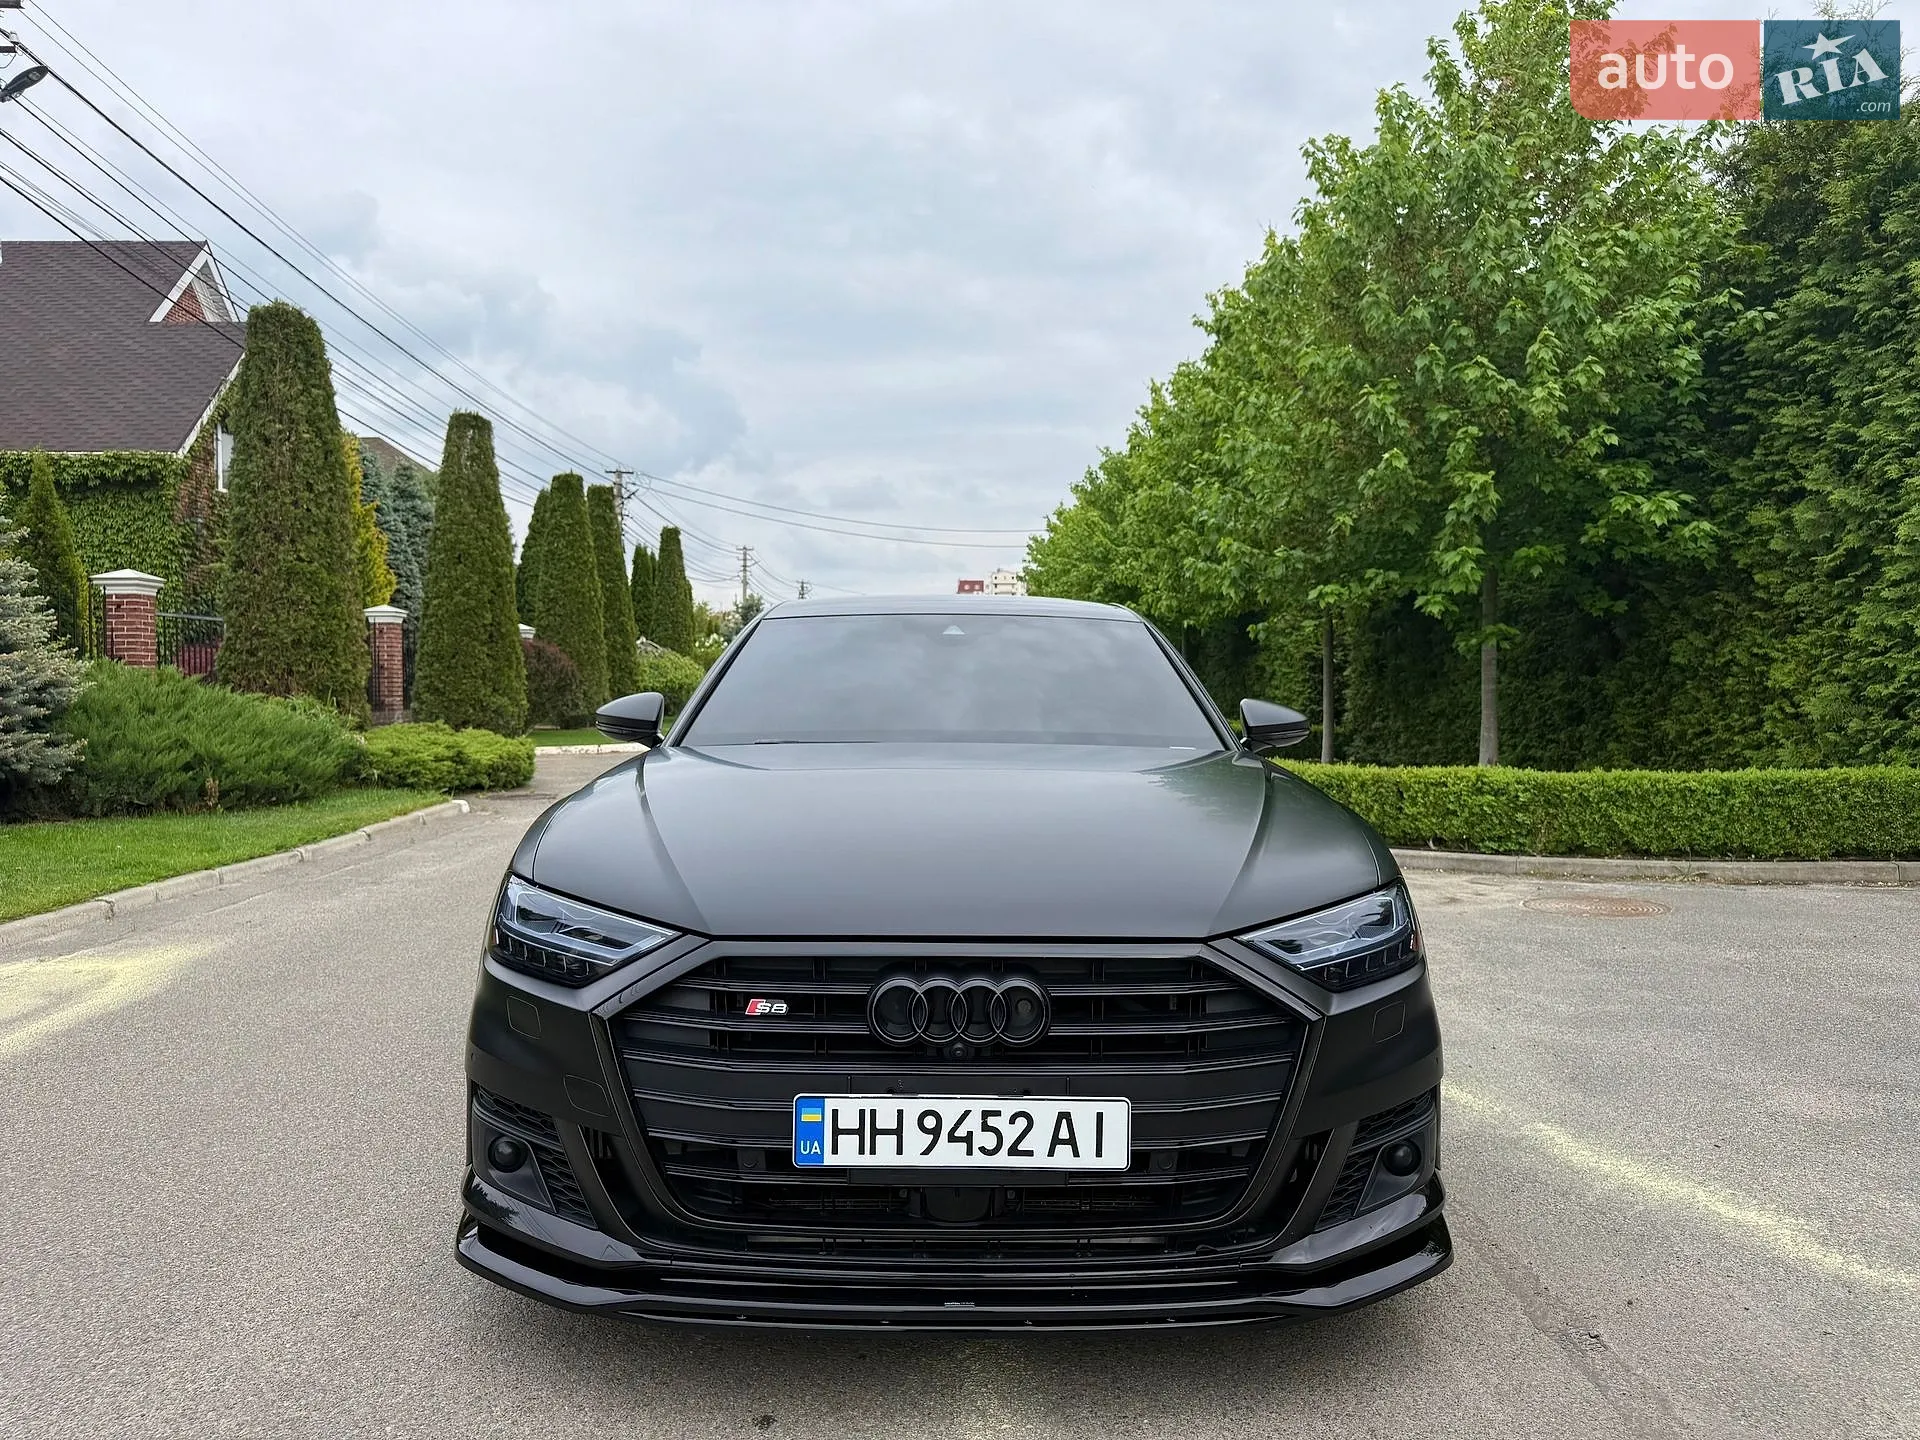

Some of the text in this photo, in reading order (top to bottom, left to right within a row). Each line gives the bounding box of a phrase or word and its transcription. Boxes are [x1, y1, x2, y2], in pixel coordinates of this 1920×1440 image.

[755, 1002, 788, 1014] S8
[831, 1108, 904, 1156] HH
[916, 1109, 1035, 1157] 9452
[800, 1140, 822, 1155] UA
